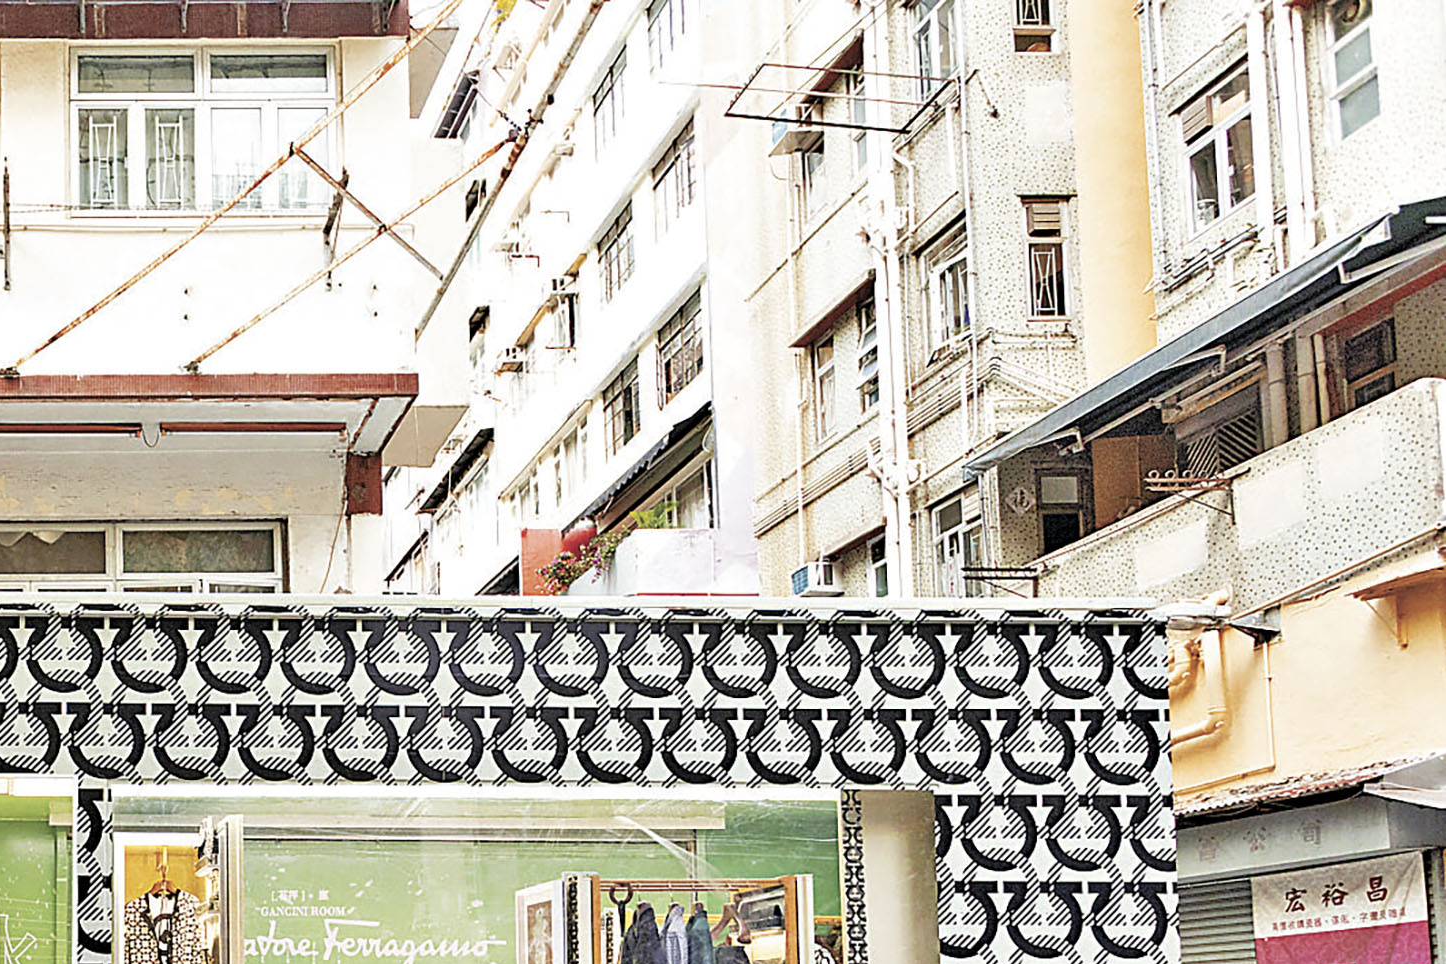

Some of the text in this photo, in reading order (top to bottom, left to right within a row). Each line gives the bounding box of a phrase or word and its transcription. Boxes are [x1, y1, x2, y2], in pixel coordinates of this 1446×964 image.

[1285, 875, 1389, 913] 宏裕昌
[311, 905, 346, 917] ROOM
